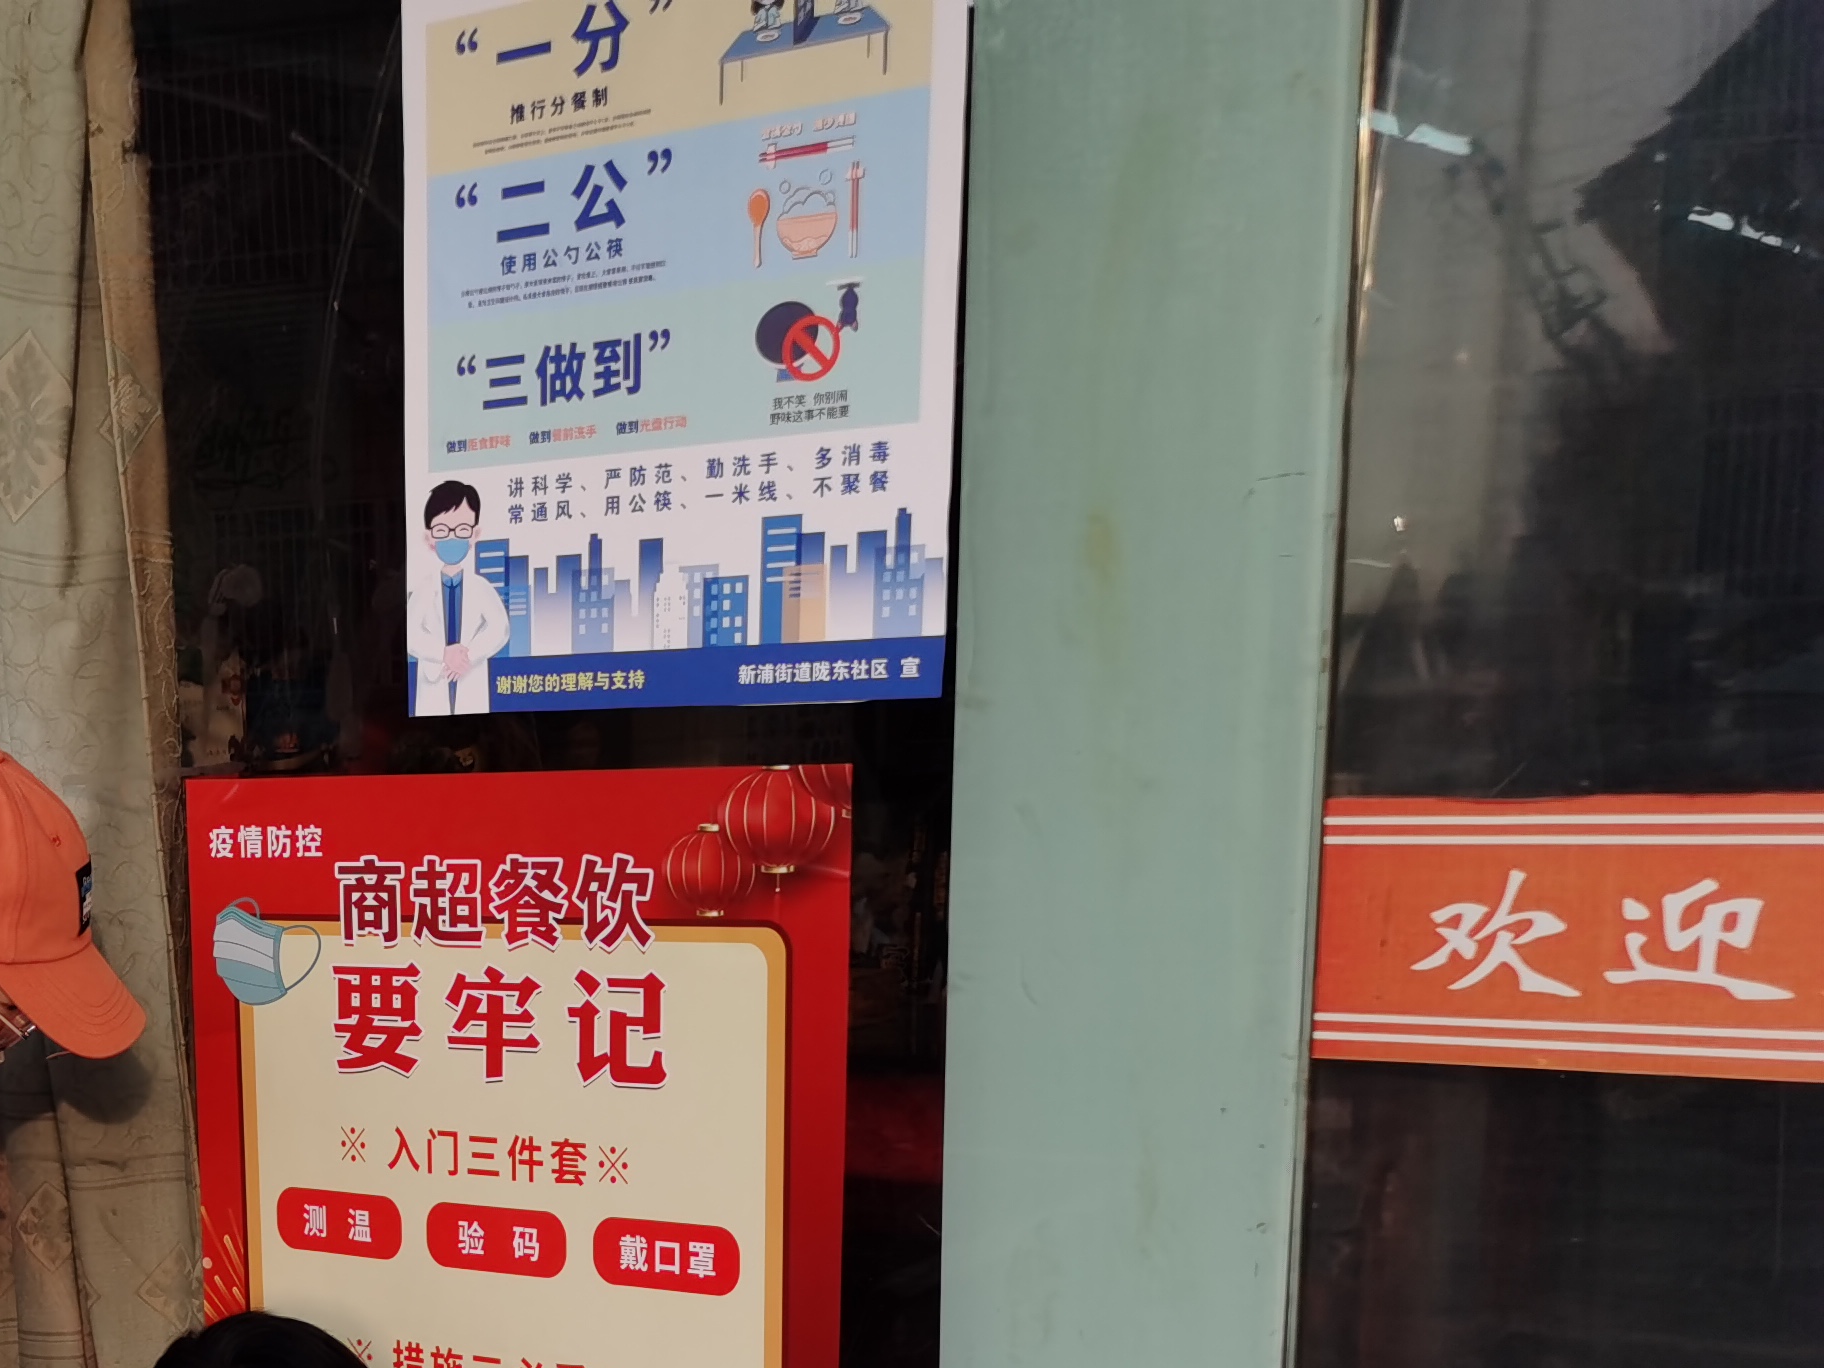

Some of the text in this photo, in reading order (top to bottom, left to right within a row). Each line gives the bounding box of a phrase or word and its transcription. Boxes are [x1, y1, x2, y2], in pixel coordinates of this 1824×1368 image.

[509, 86, 609, 125] 推行分餐制
[500, 237, 624, 277] 使用公勺公筷
[769, 404, 850, 426] 野味这事不能要
[496, 668, 645, 696] 谢谢您的理解与支持
[738, 656, 921, 686] 新浦街道陇东社区 宣
[208, 823, 324, 860] 疫情防控
[332, 853, 656, 953] 商超餐饮
[1409, 869, 1796, 1001] 欢迎
[330, 961, 670, 1088] 要牢记
[387, 1126, 590, 1187] 入门三件套
[302, 1203, 718, 1280] 测温 验码 戴口罩
